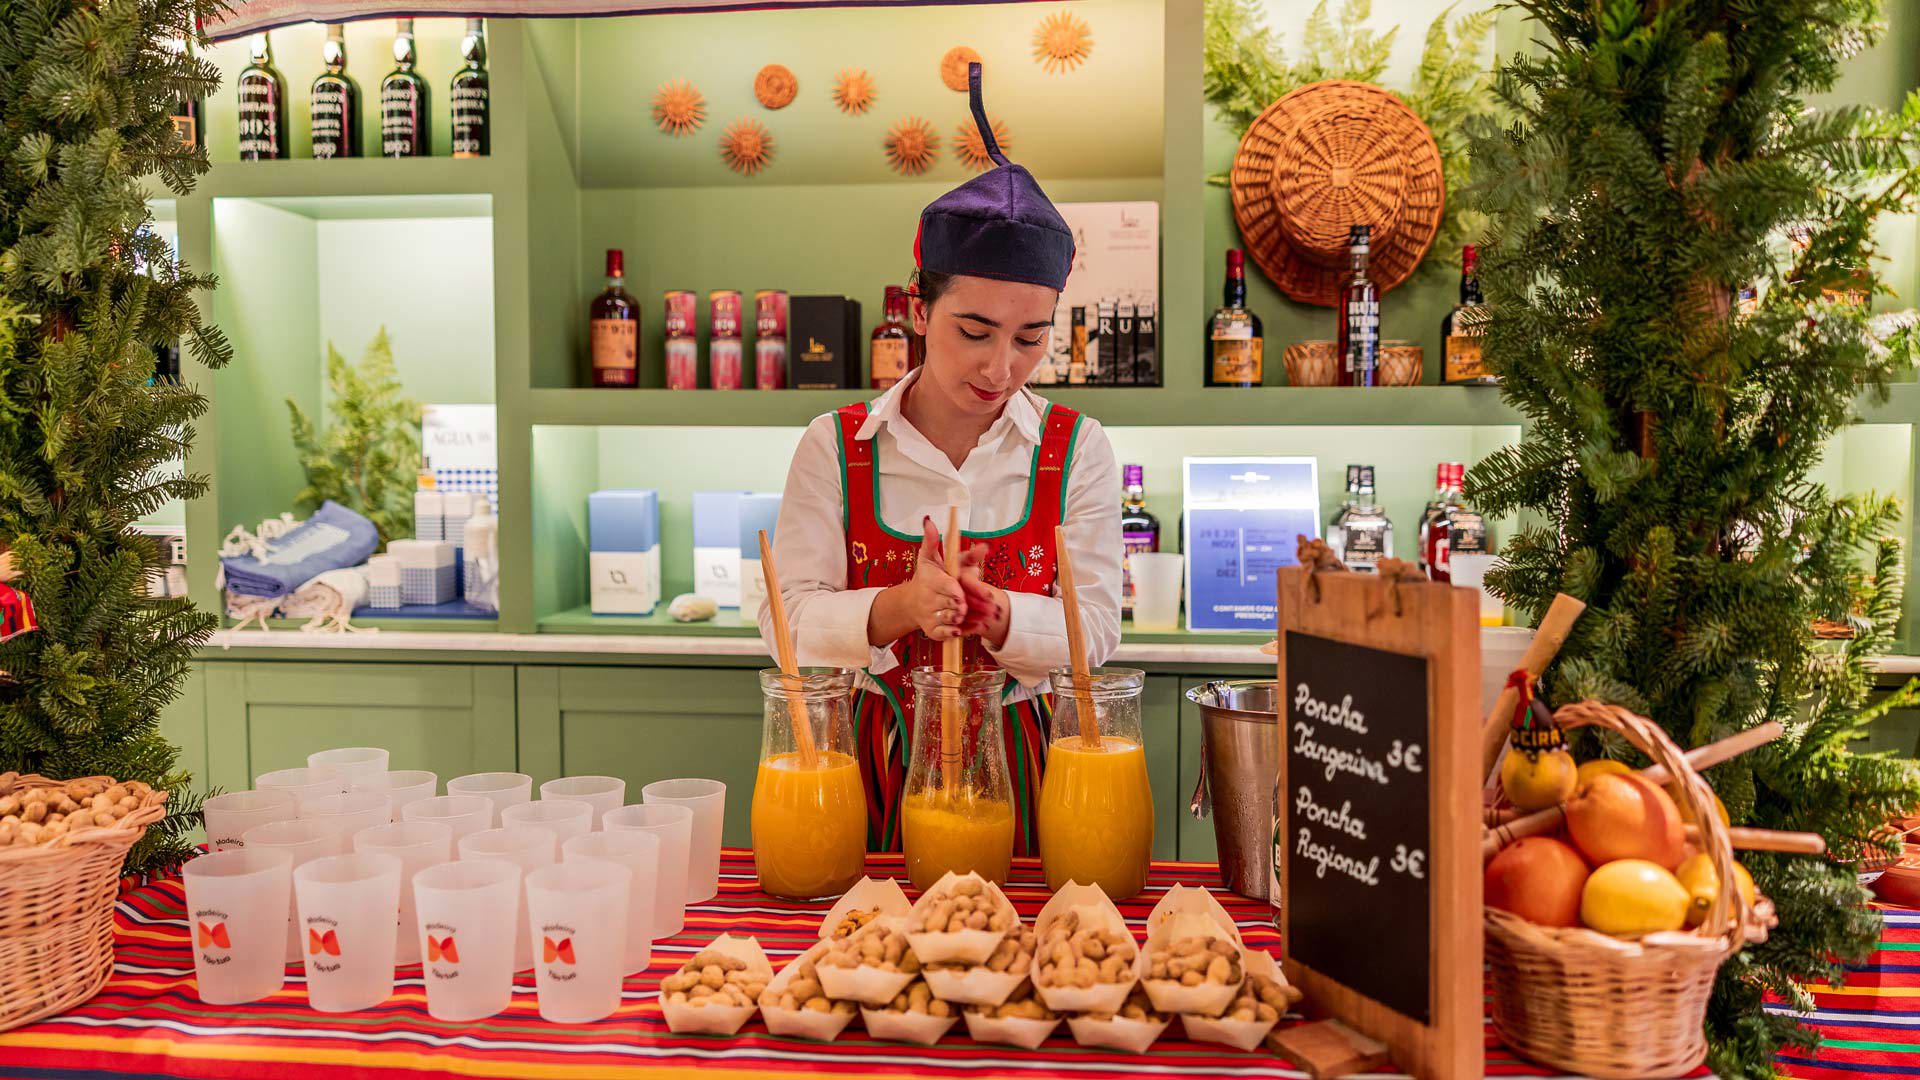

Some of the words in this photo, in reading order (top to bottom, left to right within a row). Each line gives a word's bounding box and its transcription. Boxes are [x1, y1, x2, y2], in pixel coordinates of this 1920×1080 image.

[1211, 540, 1236, 549] NOV
[1216, 568, 1237, 578] DEZ
[1294, 682, 1369, 734] Poncha
[1386, 739, 1423, 773] 3€
[1295, 785, 1367, 840] Poncha
[215, 837, 245, 847] Madeira
[1295, 827, 1380, 886] Regional
[1390, 844, 1425, 879] 3€
[195, 909, 229, 920] Madeira
[306, 915, 338, 927] Madeira
